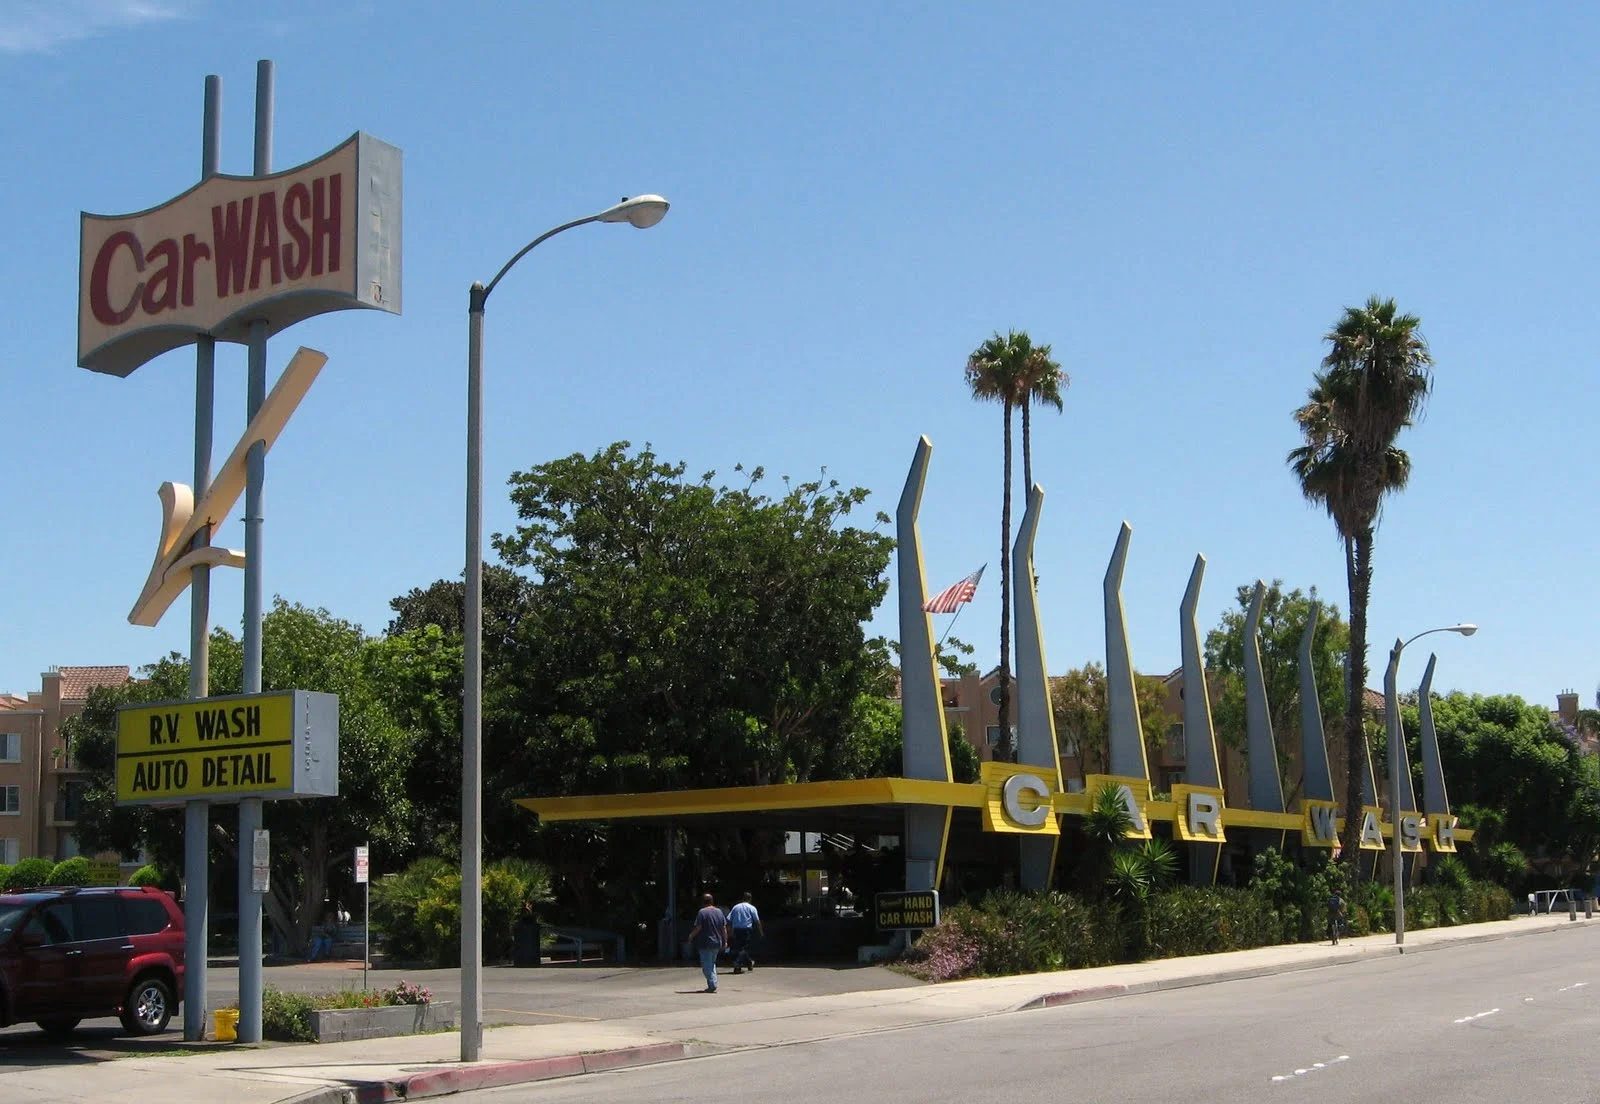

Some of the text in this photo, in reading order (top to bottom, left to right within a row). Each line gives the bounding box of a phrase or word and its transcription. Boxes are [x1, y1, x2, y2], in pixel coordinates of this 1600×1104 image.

[149, 706, 261, 745] R.V. WASH
[132, 752, 276, 793] AUTO DETAIL
[1310, 806, 1455, 851] WASH
[880, 910, 933, 925] CAR WASH
[905, 896, 932, 909] HAND
